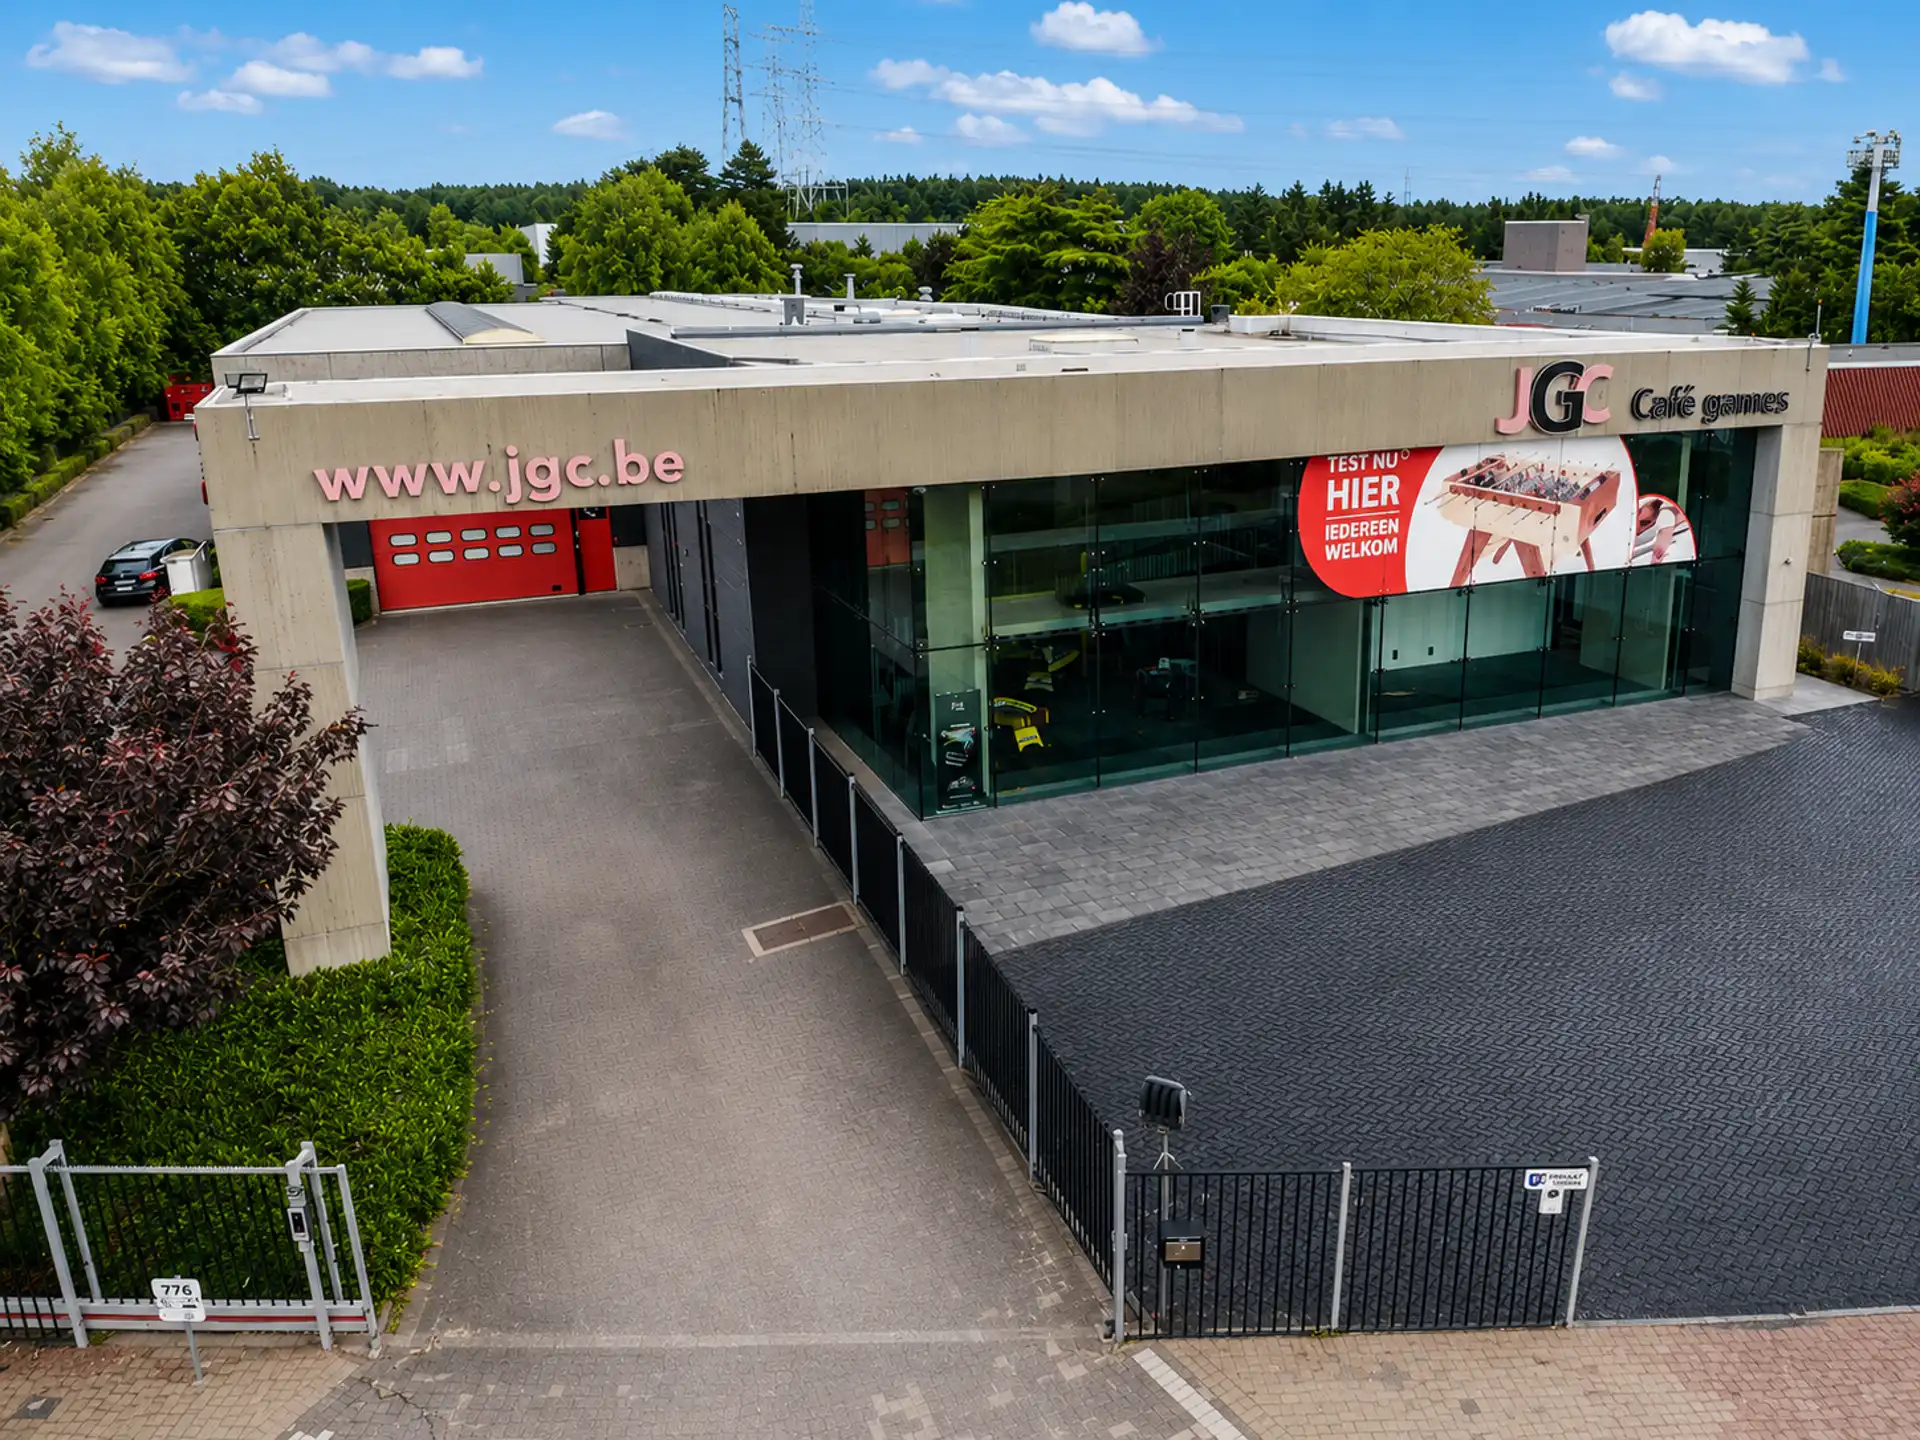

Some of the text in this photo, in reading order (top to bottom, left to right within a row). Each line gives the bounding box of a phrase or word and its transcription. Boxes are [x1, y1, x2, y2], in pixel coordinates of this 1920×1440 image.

[1494, 359, 1614, 435] JGC
[1630, 385, 1790, 424] Café games
[313, 438, 685, 504] www.jgc.be
[1328, 451, 1398, 473] TEST NU
[1326, 475, 1400, 511] HIER
[1325, 518, 1399, 541] IEDEREEN
[1325, 537, 1398, 561] WELKOM
[161, 1285, 192, 1296] 776
